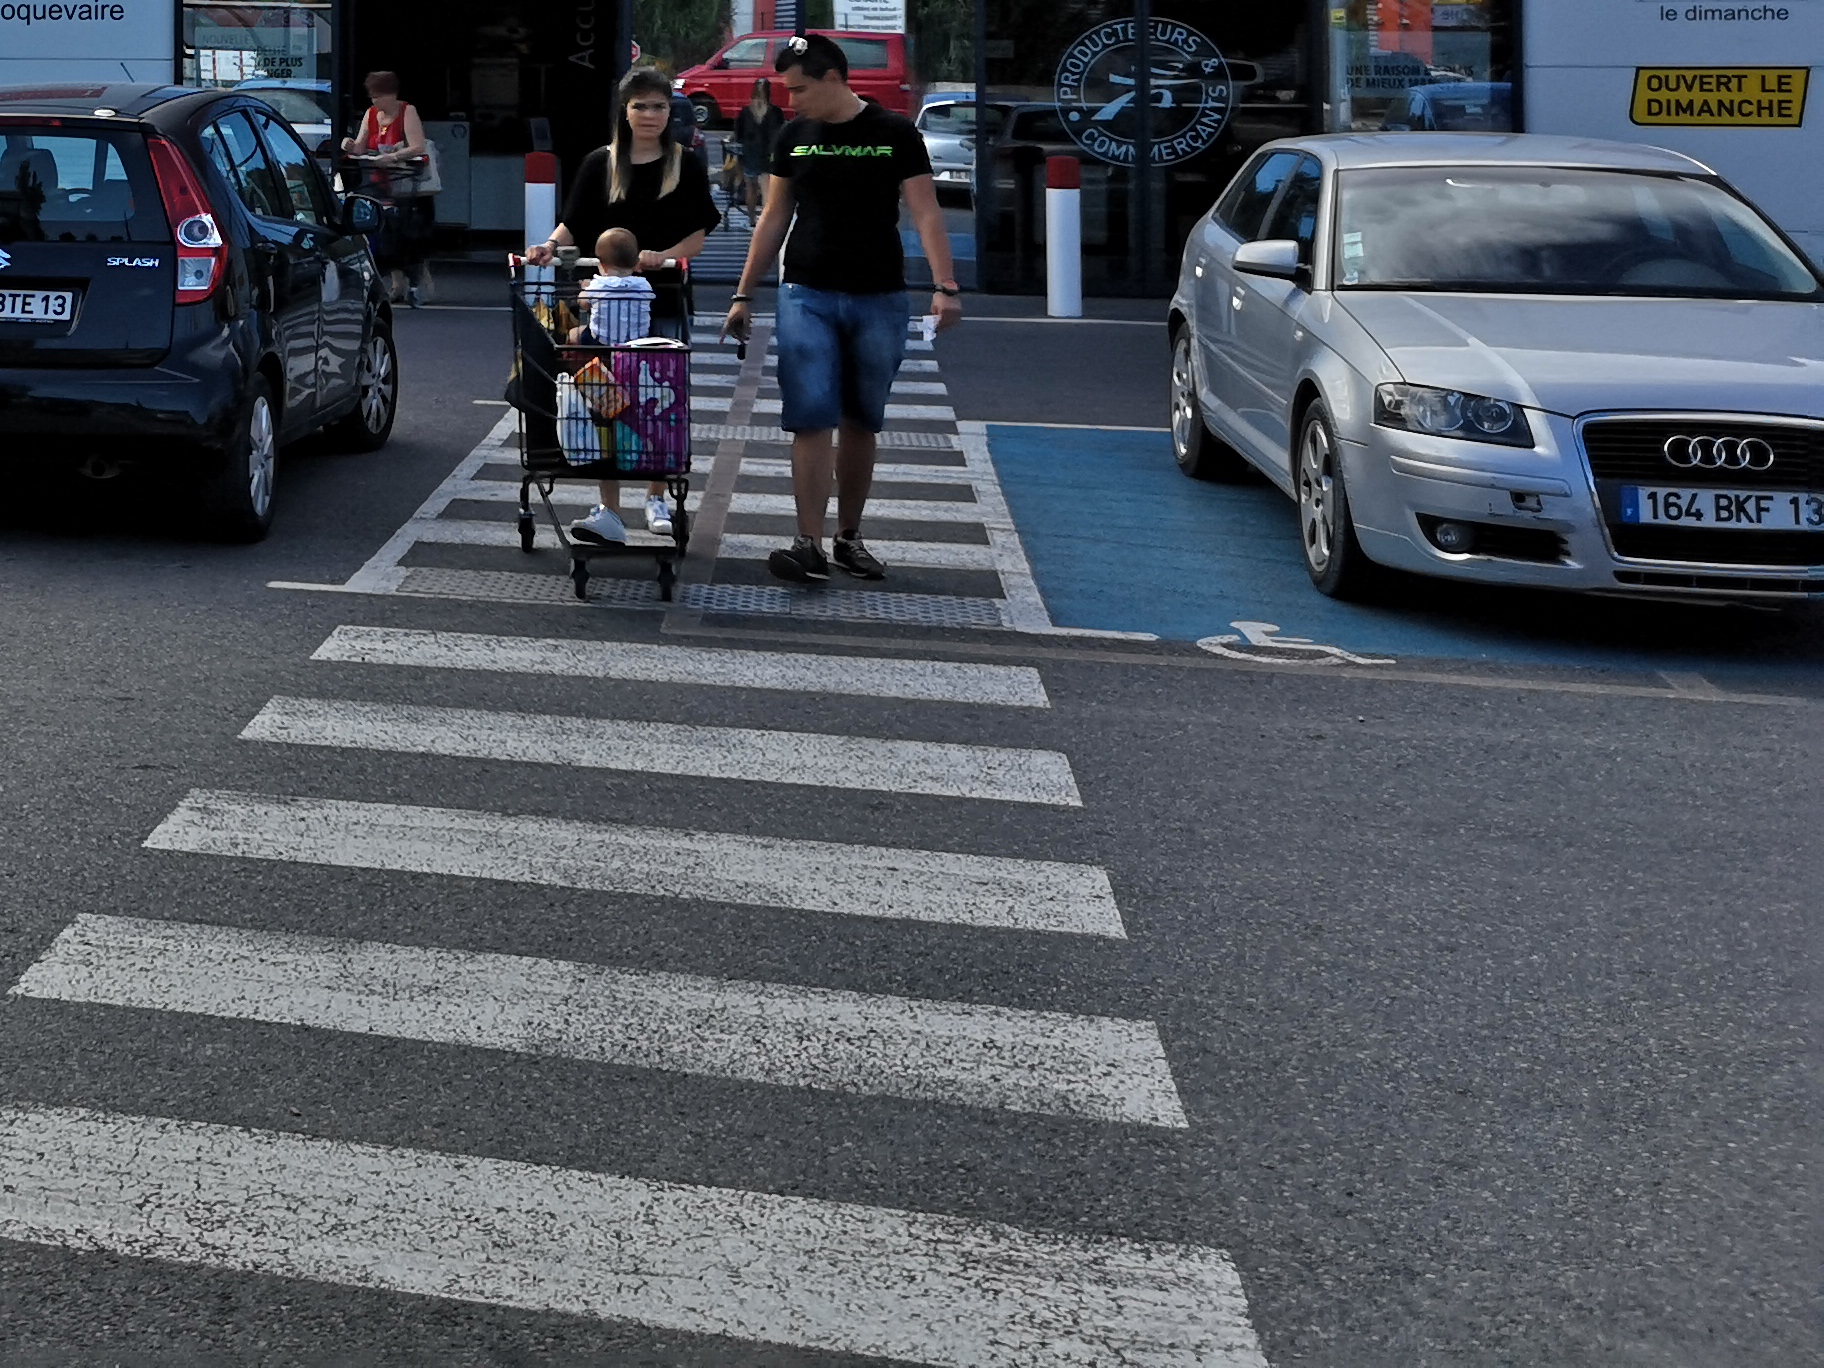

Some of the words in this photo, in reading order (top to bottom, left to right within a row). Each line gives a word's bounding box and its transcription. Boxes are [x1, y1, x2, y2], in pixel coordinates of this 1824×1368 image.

[1659, 4, 1678, 22] le
[1684, 4, 1790, 21] dimanche
[1059, 22, 1202, 100] PRODUCTEURS
[1646, 73, 1748, 94] OUVERT
[1760, 74, 1793, 94] LE
[1646, 98, 1794, 118] DIMANCHE
[106, 256, 160, 269] SPLASH
[40, 294, 67, 316] 13
[1646, 491, 1704, 522] 164
[1714, 493, 1774, 524] BKF
[1789, 495, 1824, 526] 13
